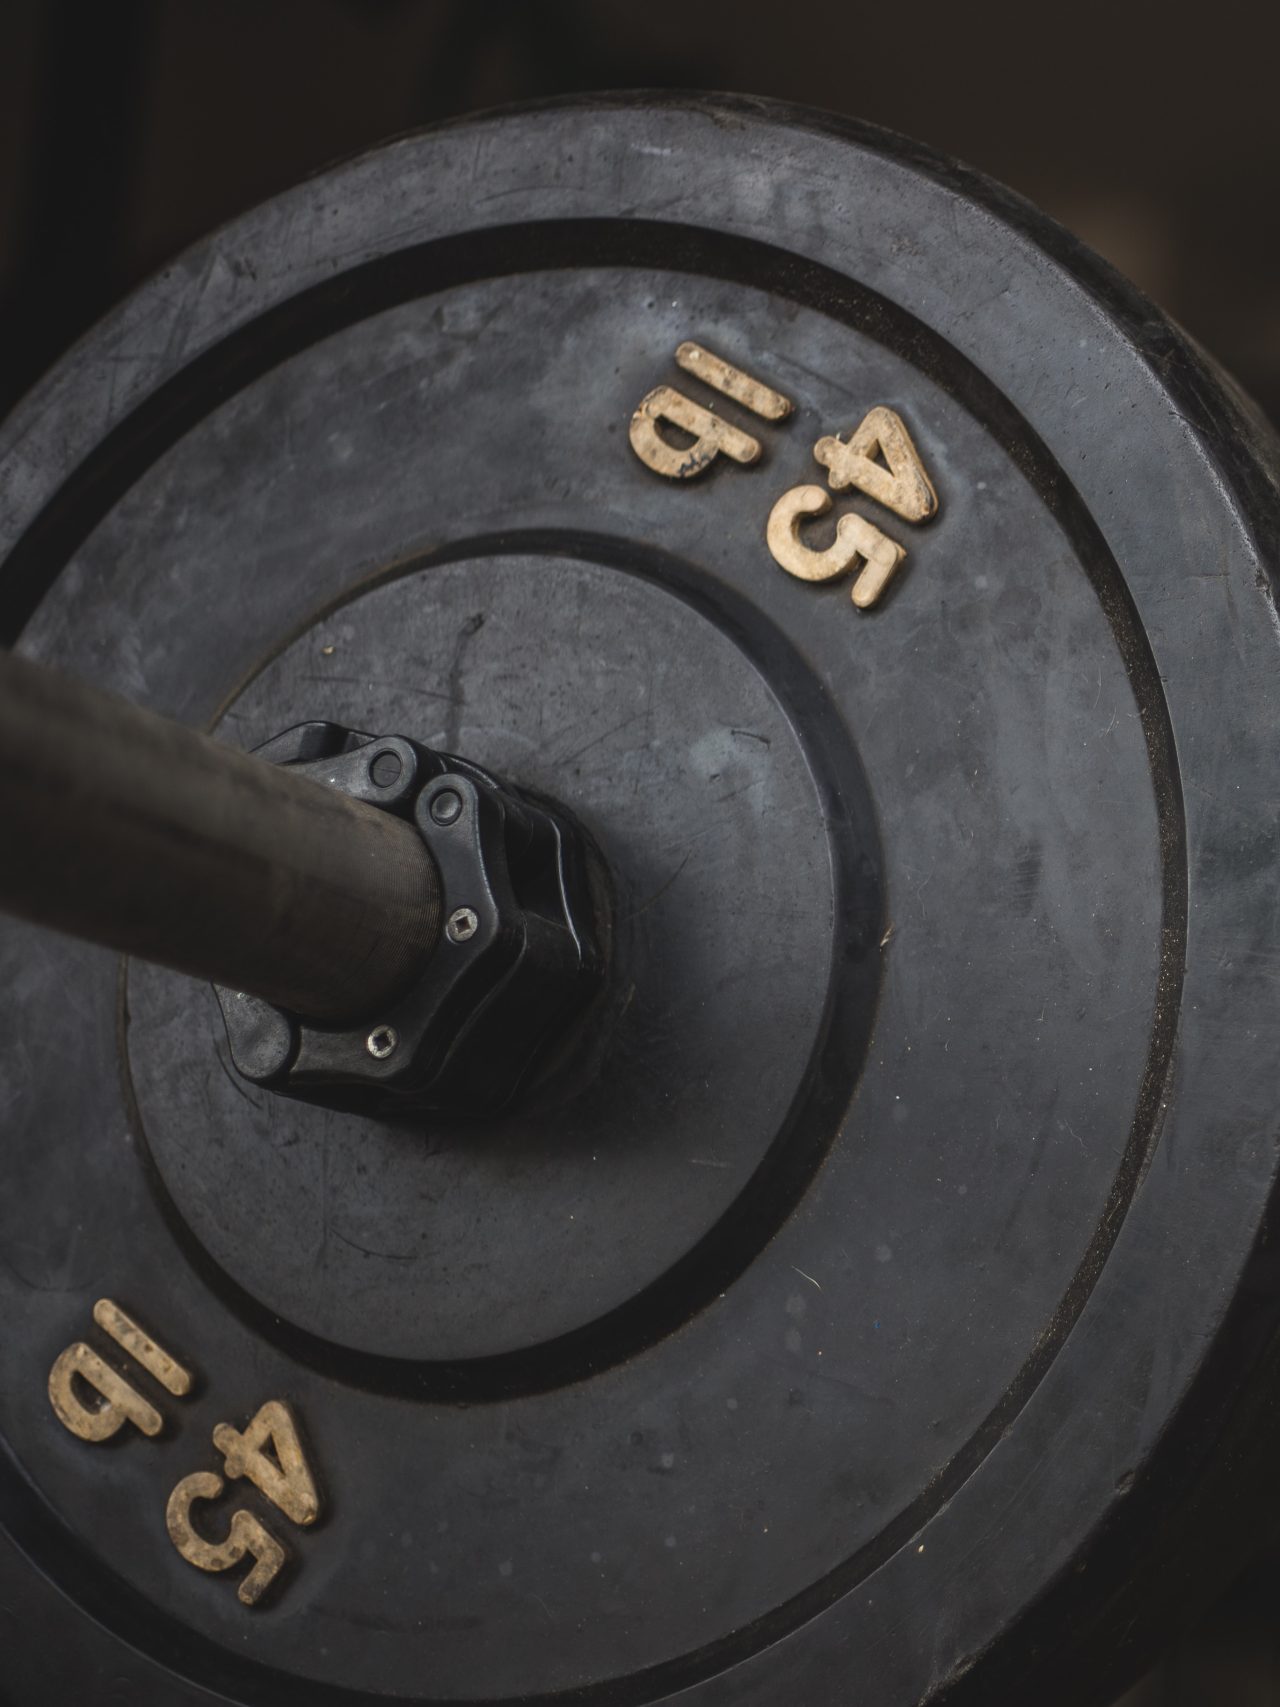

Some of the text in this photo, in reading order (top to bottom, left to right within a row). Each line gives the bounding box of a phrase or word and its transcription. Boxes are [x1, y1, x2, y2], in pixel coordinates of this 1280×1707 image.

[629, 340, 791, 478] lb
[766, 405, 938, 608] 45
[48, 1298, 190, 1442] lb
[166, 1400, 318, 1605] 45
